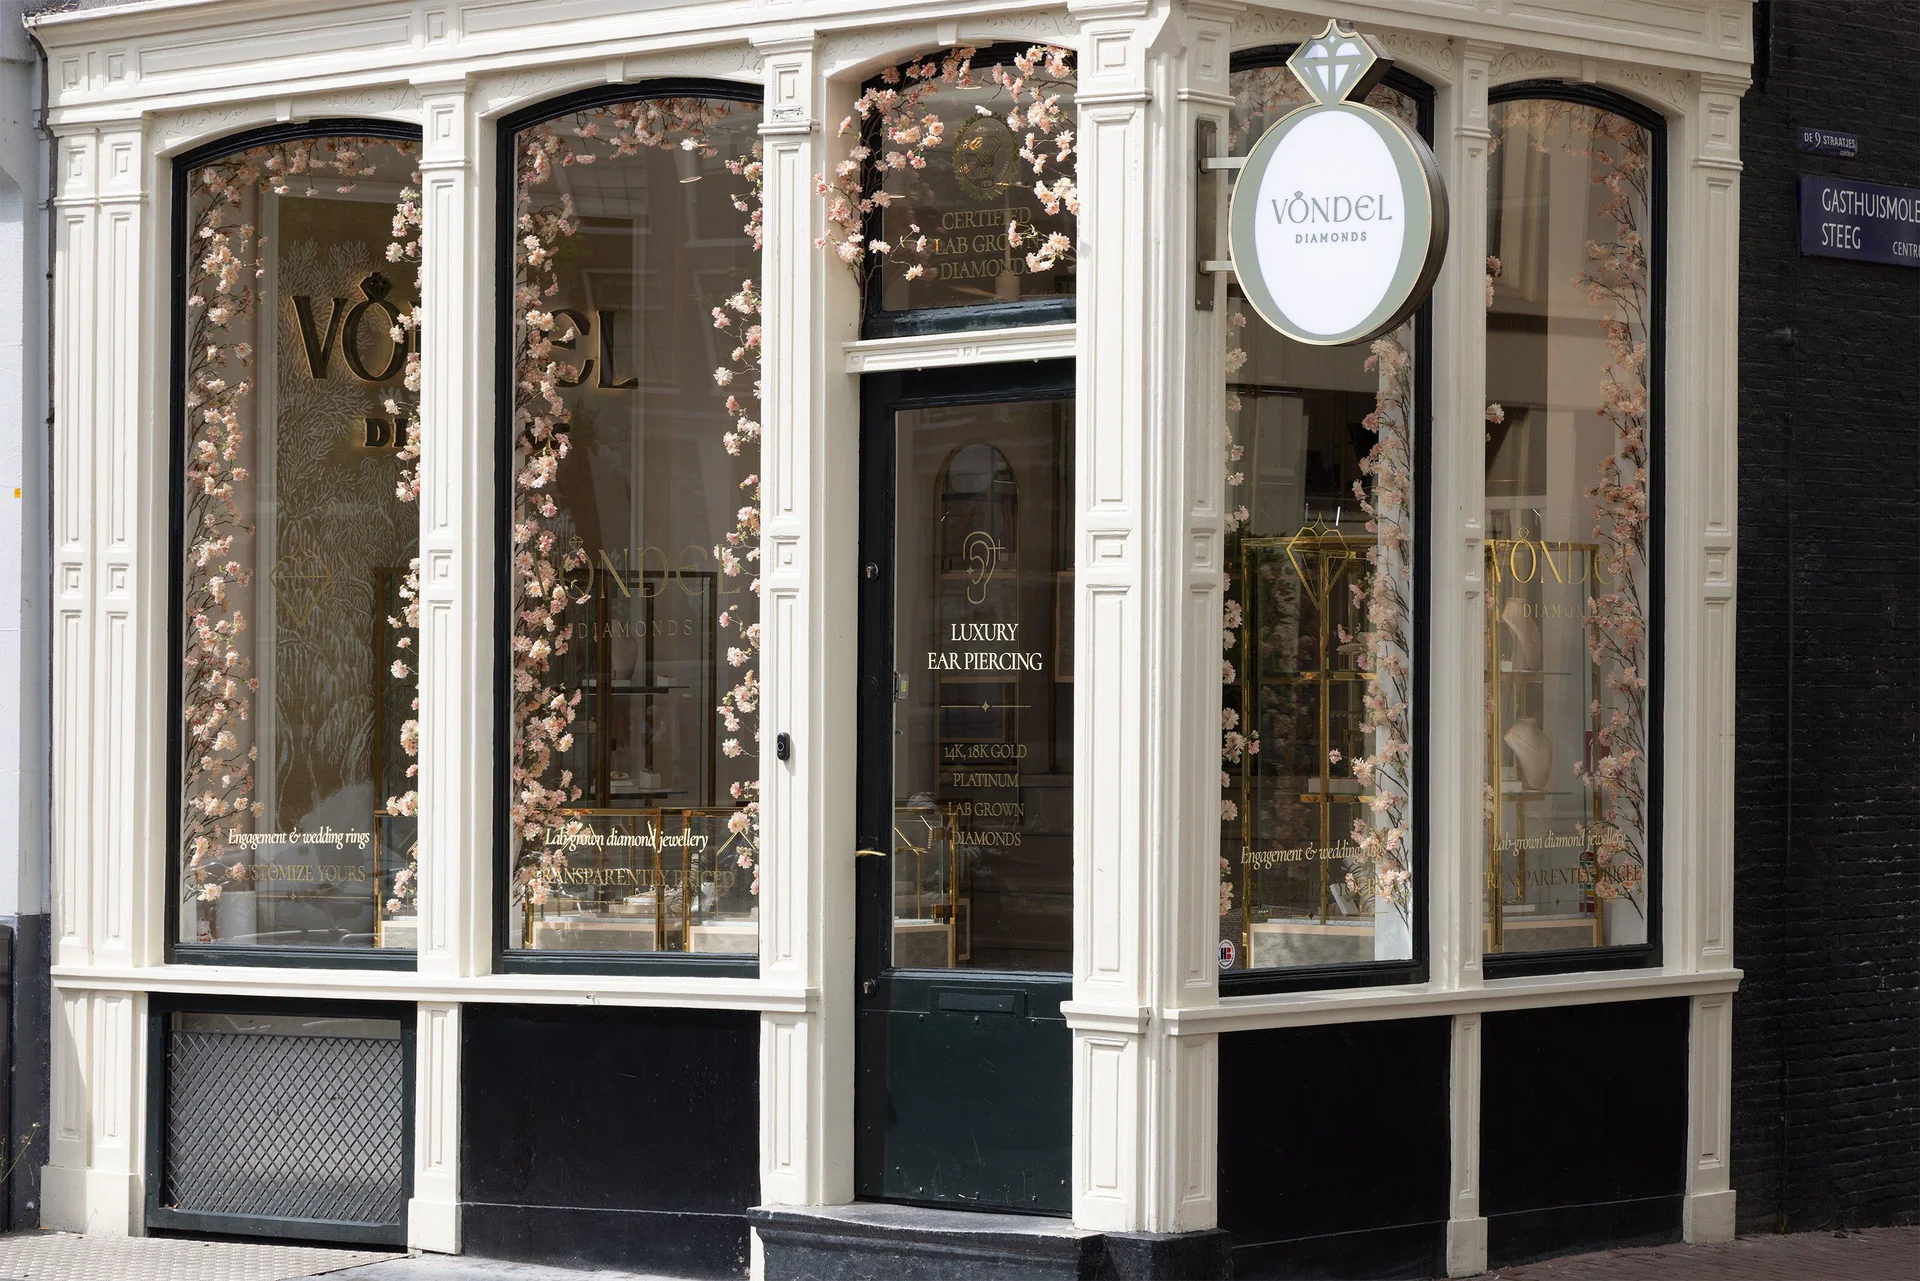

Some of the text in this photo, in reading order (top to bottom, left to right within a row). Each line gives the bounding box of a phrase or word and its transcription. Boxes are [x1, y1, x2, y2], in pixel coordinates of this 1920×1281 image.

[1804, 131, 1856, 149] DE 9 STRAATJES
[1271, 193, 1393, 225] VONDEL
[1821, 188, 1920, 223] GASTHUISMOLE
[934, 233, 1042, 256] LAB GRON
[1295, 231, 1368, 244] DIAMONDS
[1821, 222, 1861, 250] STEEG
[578, 619, 692, 640] DIAMONDS
[951, 623, 1019, 641] LUXURY
[927, 652, 1043, 671] EAR PIERCING
[944, 744, 1027, 760] 14K, 18K GOLD
[953, 773, 1019, 788] PLATINUM
[948, 802, 1025, 817] LAB GROWN
[228, 826, 370, 850] Engagement & wedding rings
[606, 827, 657, 848] diamond
[659, 828, 709, 853] jewellery
[953, 831, 1021, 846] DIAMONDS
[1493, 826, 1626, 857] Lab-grown diamond jewellery
[1241, 845, 1303, 871] Engagement
[1305, 842, 1318, 861] &
[318, 865, 366, 883] YOURS
[536, 866, 736, 889] RANSPARENTLY PRICED
